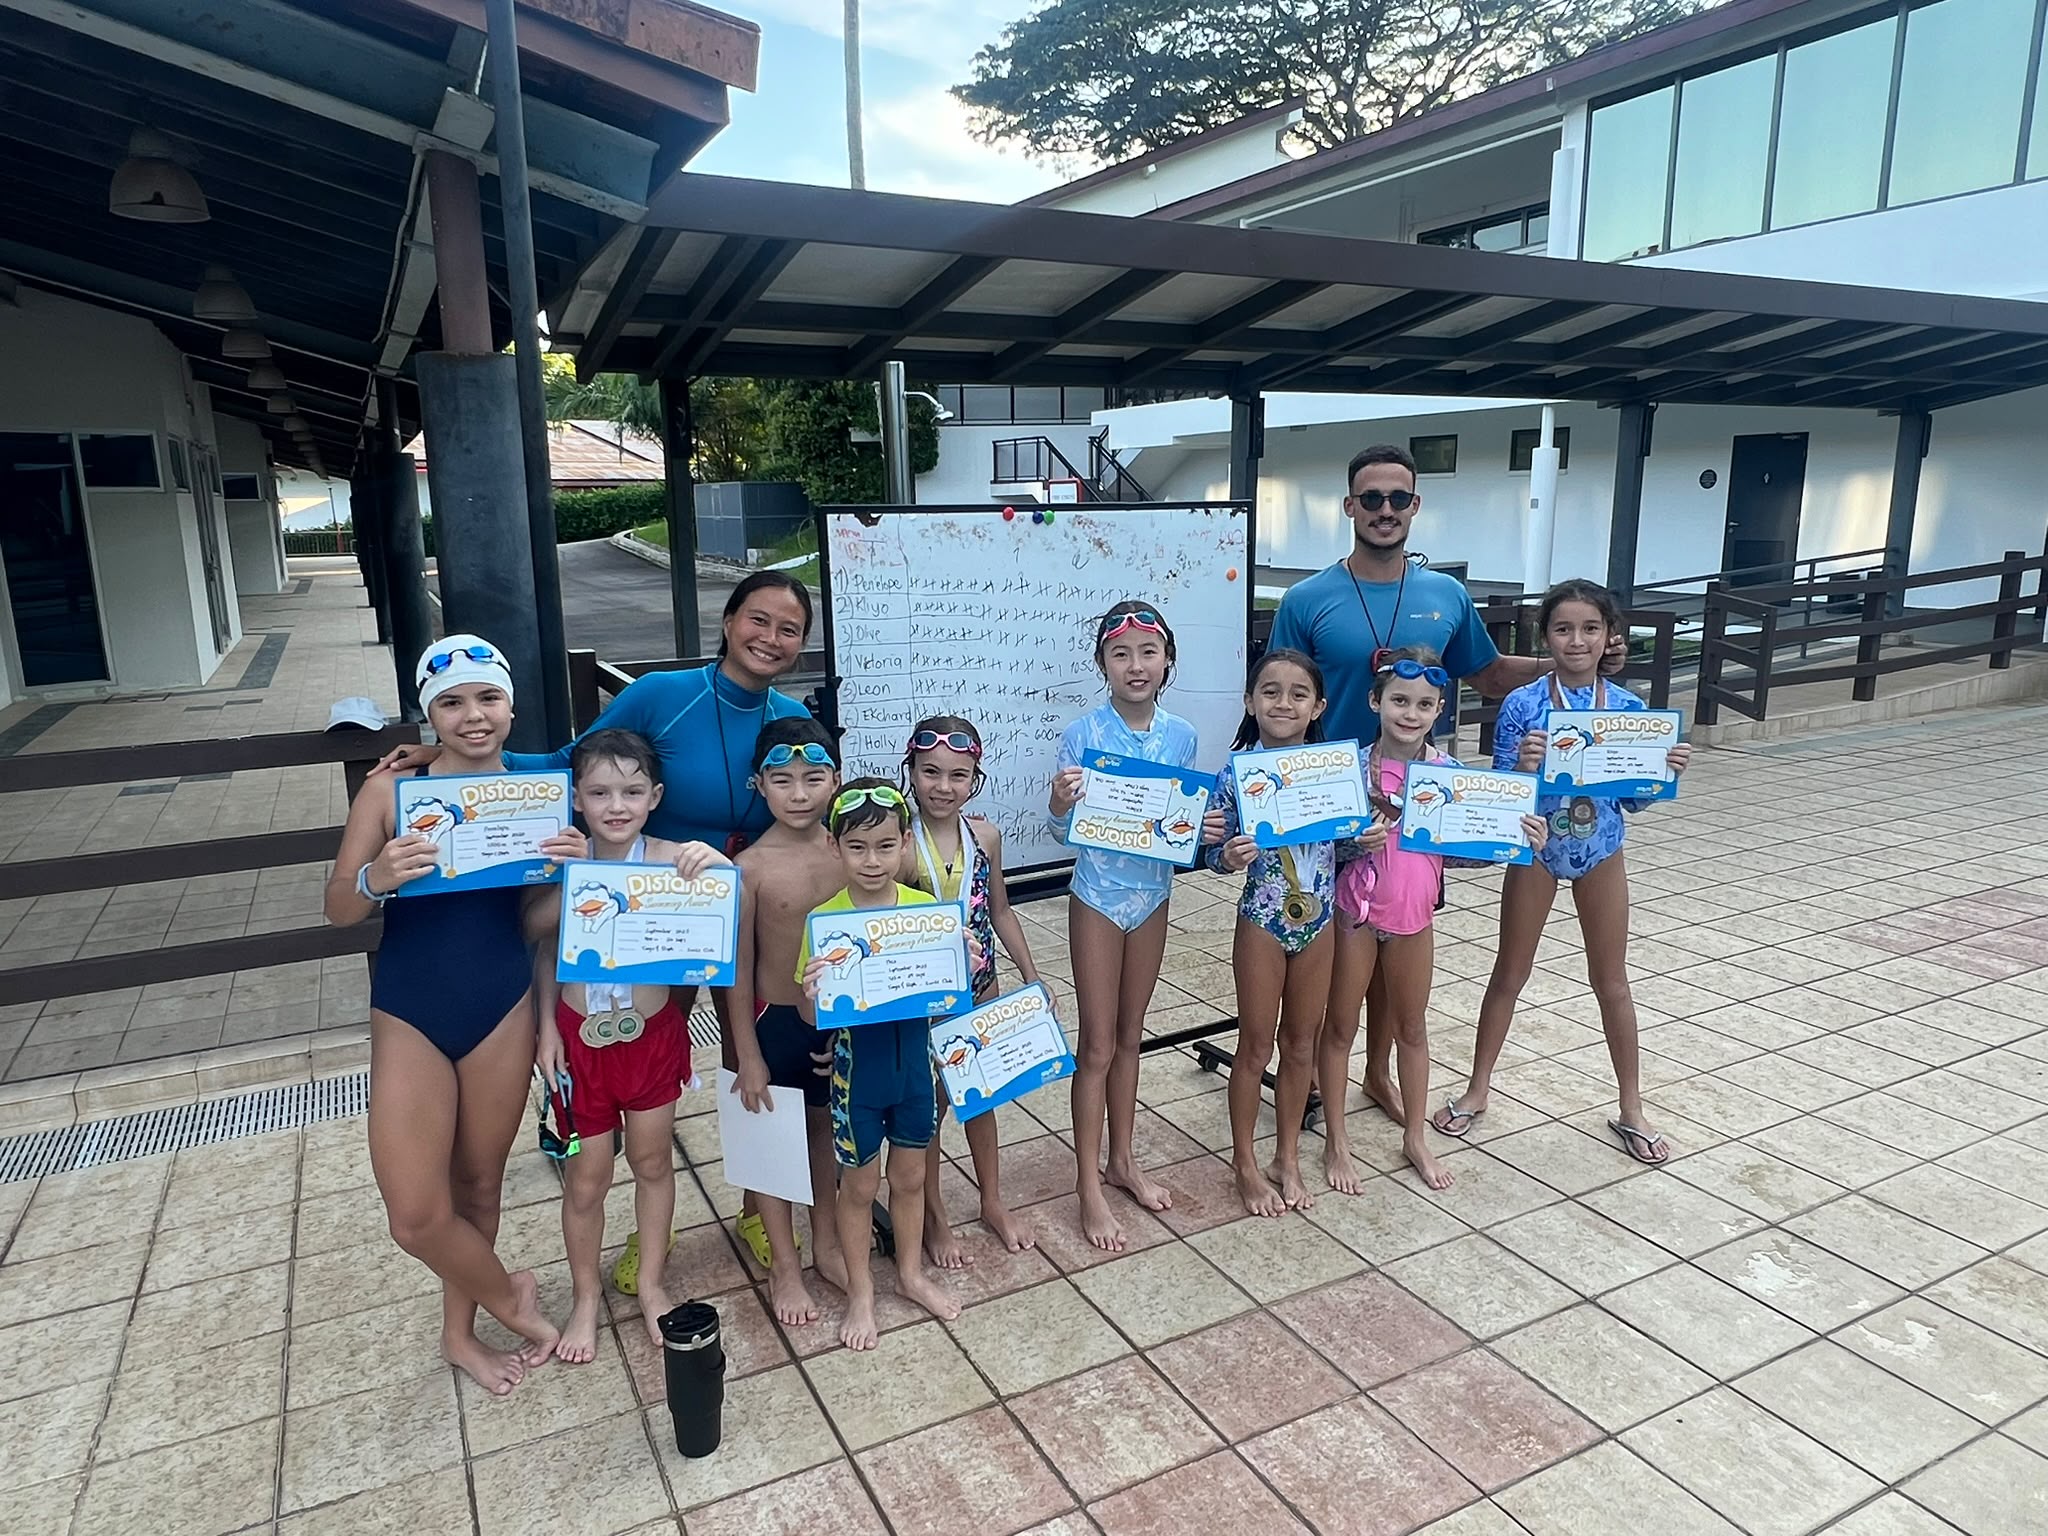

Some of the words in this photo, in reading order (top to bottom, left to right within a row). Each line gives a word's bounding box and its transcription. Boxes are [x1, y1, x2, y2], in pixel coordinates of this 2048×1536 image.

[854, 574, 903, 594] Penelope
[854, 653, 902, 672] Victoria
[858, 683, 891, 697] Leon
[1592, 714, 1673, 735] Distance
[864, 733, 897, 754] Holly
[1276, 751, 1354, 776] Distance
[461, 780, 563, 807] Distance
[1452, 774, 1531, 798] Distance
[627, 871, 731, 898] Distance
[865, 914, 957, 942] Distance
[971, 996, 1042, 1035] Distance
